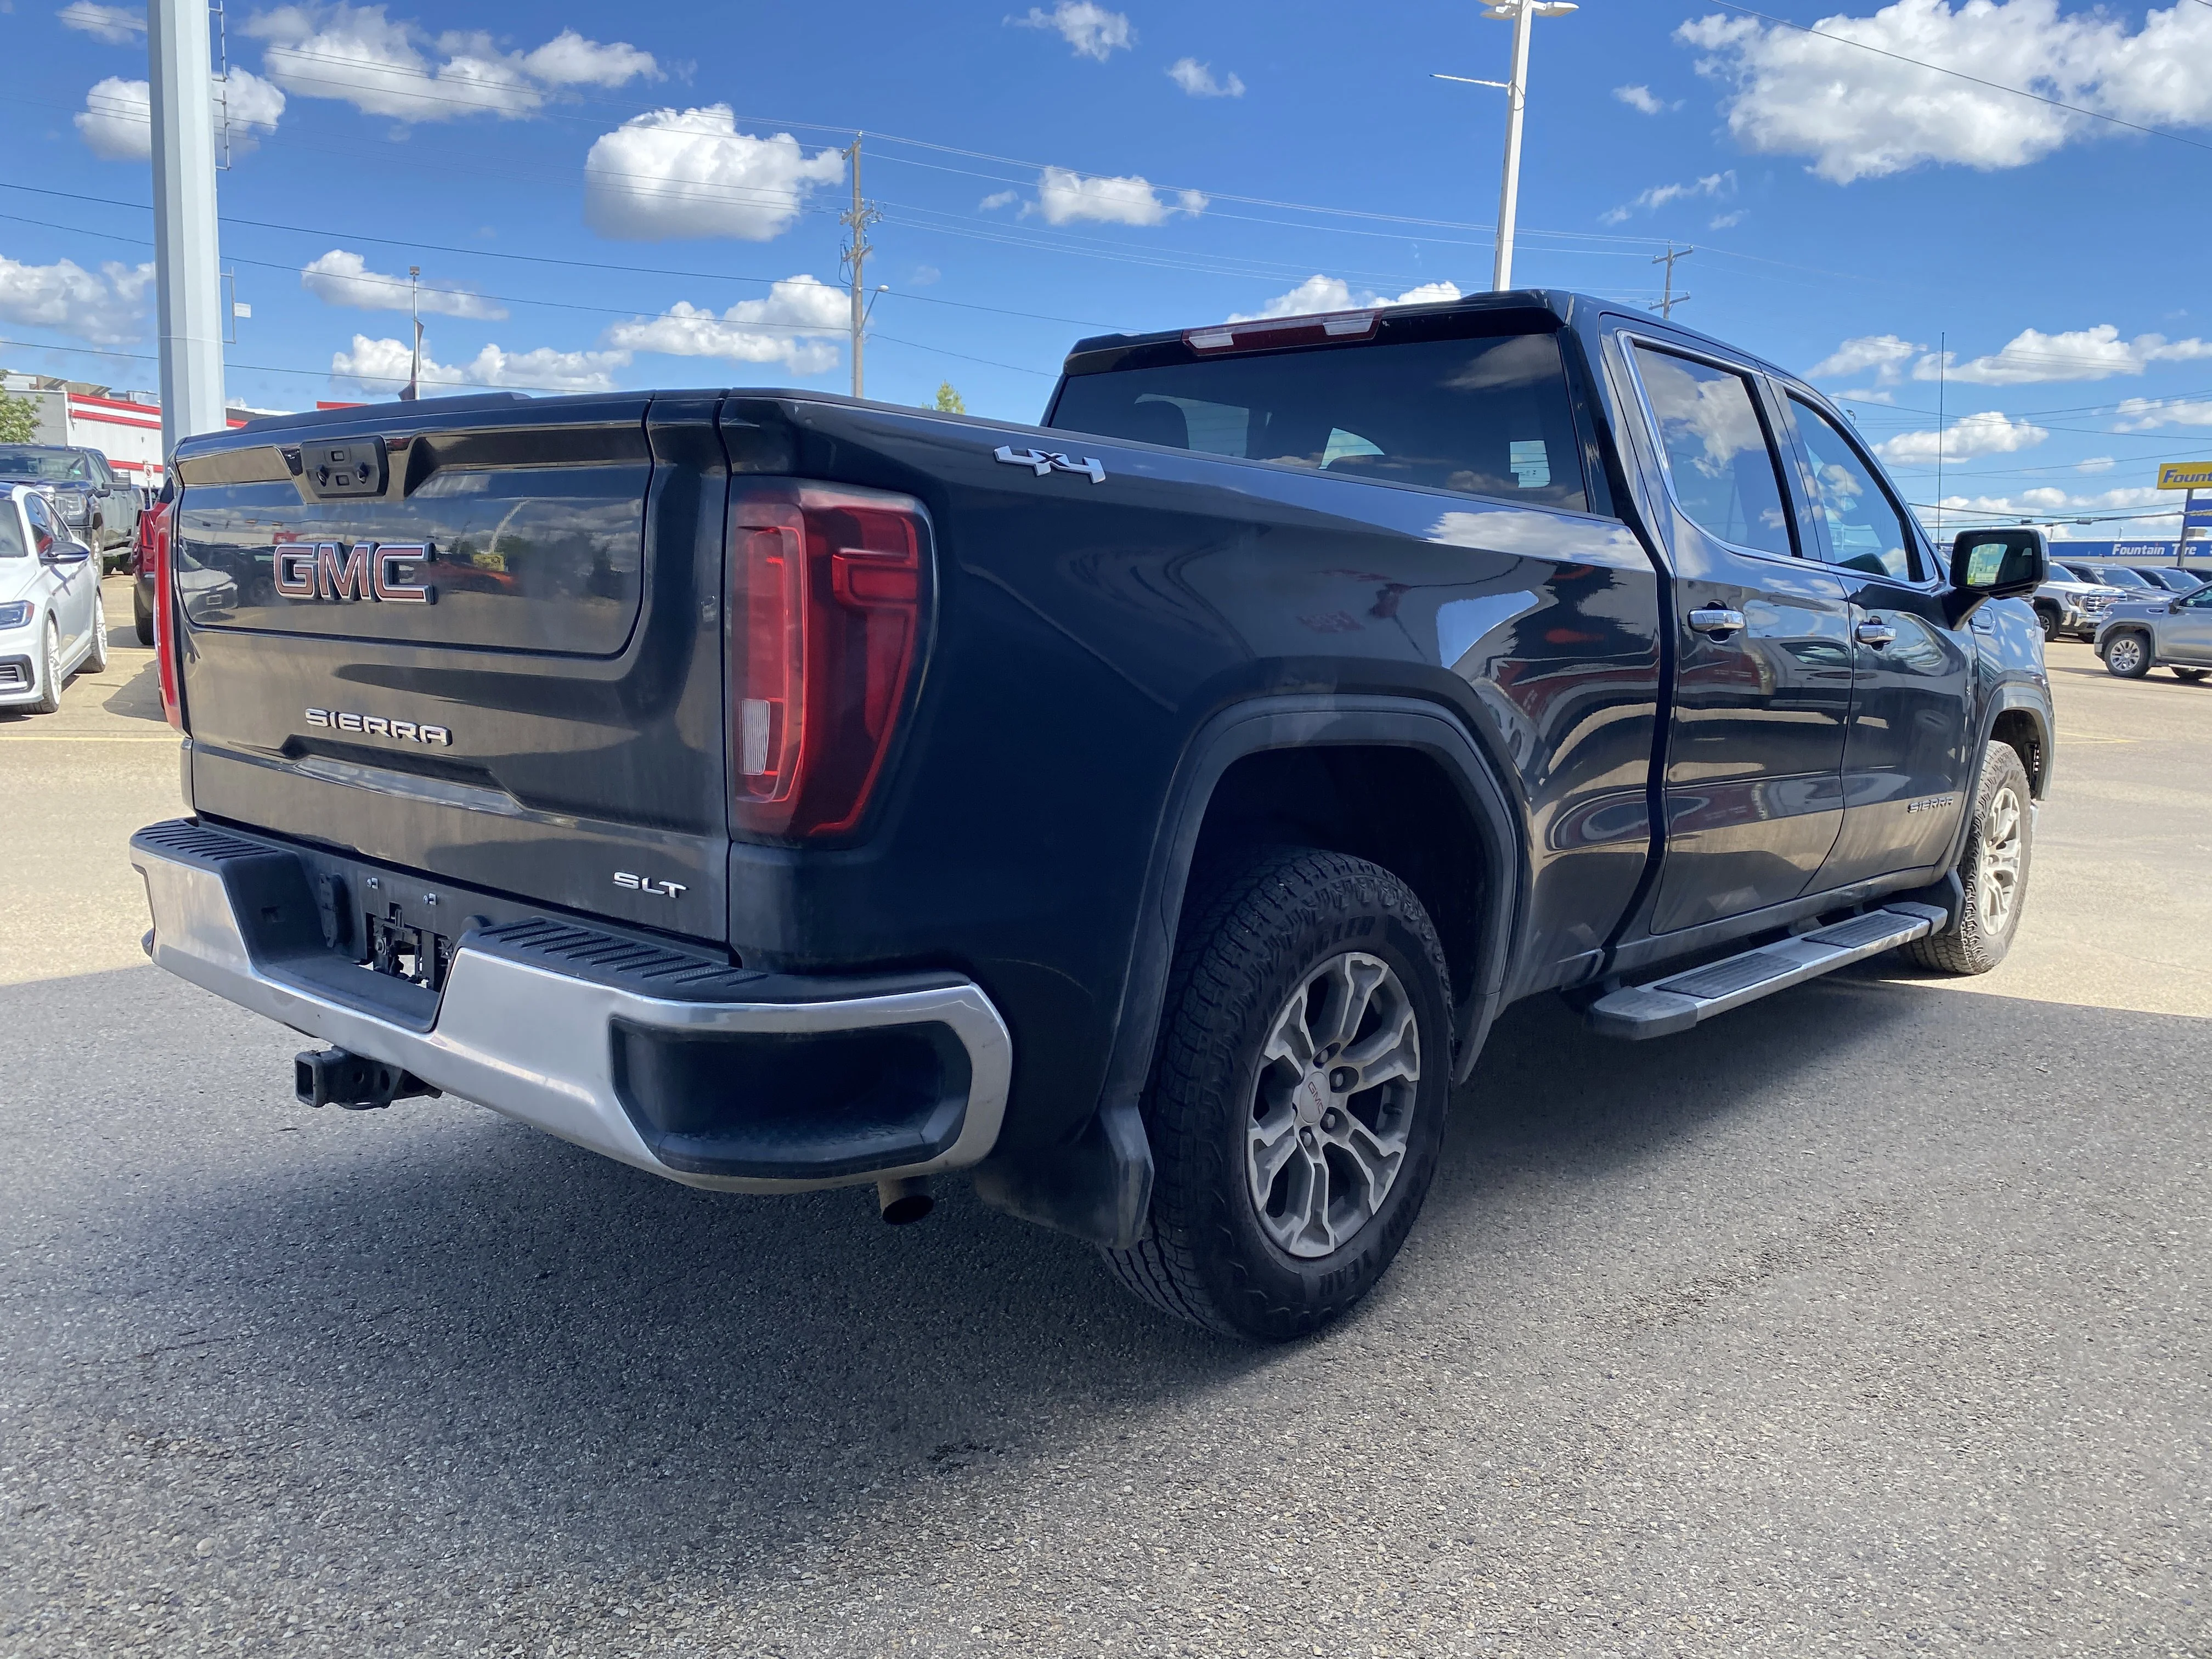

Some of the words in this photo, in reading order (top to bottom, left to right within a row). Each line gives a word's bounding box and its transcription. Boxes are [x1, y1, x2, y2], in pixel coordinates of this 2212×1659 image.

[2112, 543, 2165, 555] Fountain
[2172, 543, 2197, 555] Tre
[274, 542, 437, 605] GMC
[305, 707, 453, 746] SIERRA
[1908, 796, 1954, 813] SIERRA
[613, 871, 689, 898] SLT
[1308, 1081, 1324, 1115] GMC
